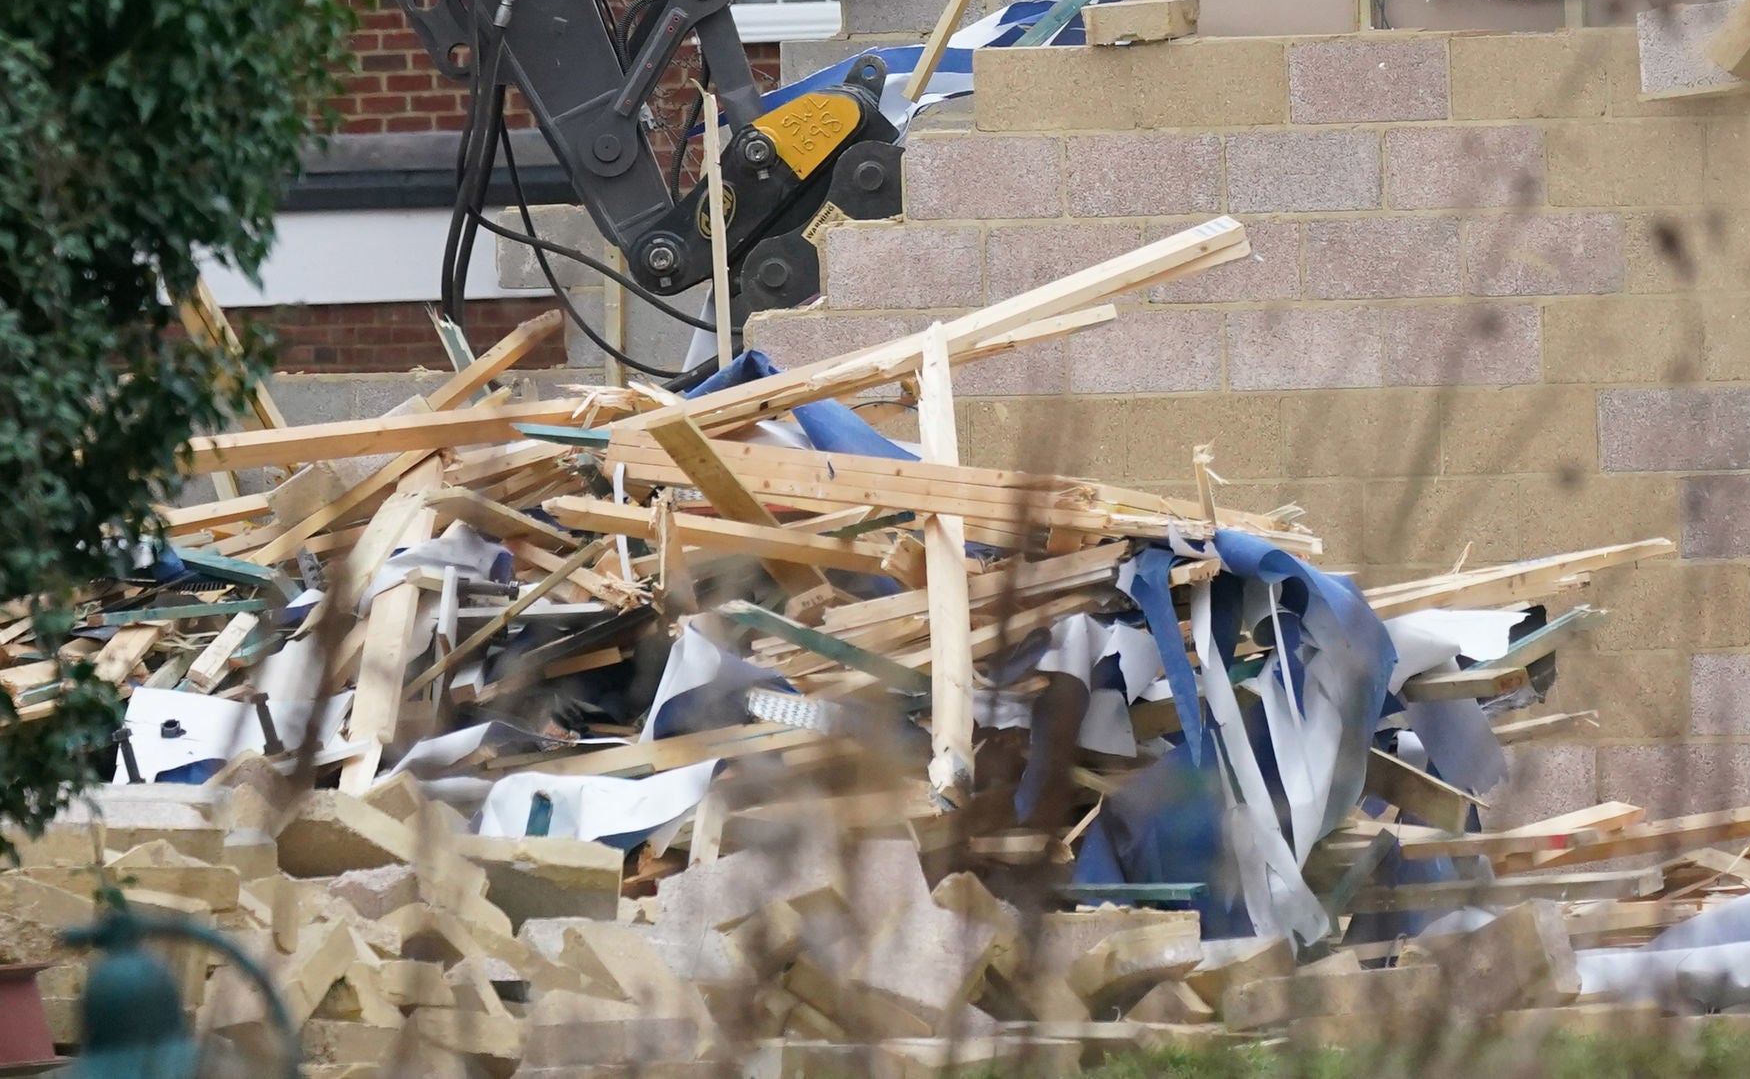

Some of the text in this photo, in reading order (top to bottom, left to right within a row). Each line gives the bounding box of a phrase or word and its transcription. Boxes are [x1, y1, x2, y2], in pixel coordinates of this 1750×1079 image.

[781, 95, 832, 138] SWL
[791, 111, 843, 155] 1698
[805, 205, 835, 240] WARNING
